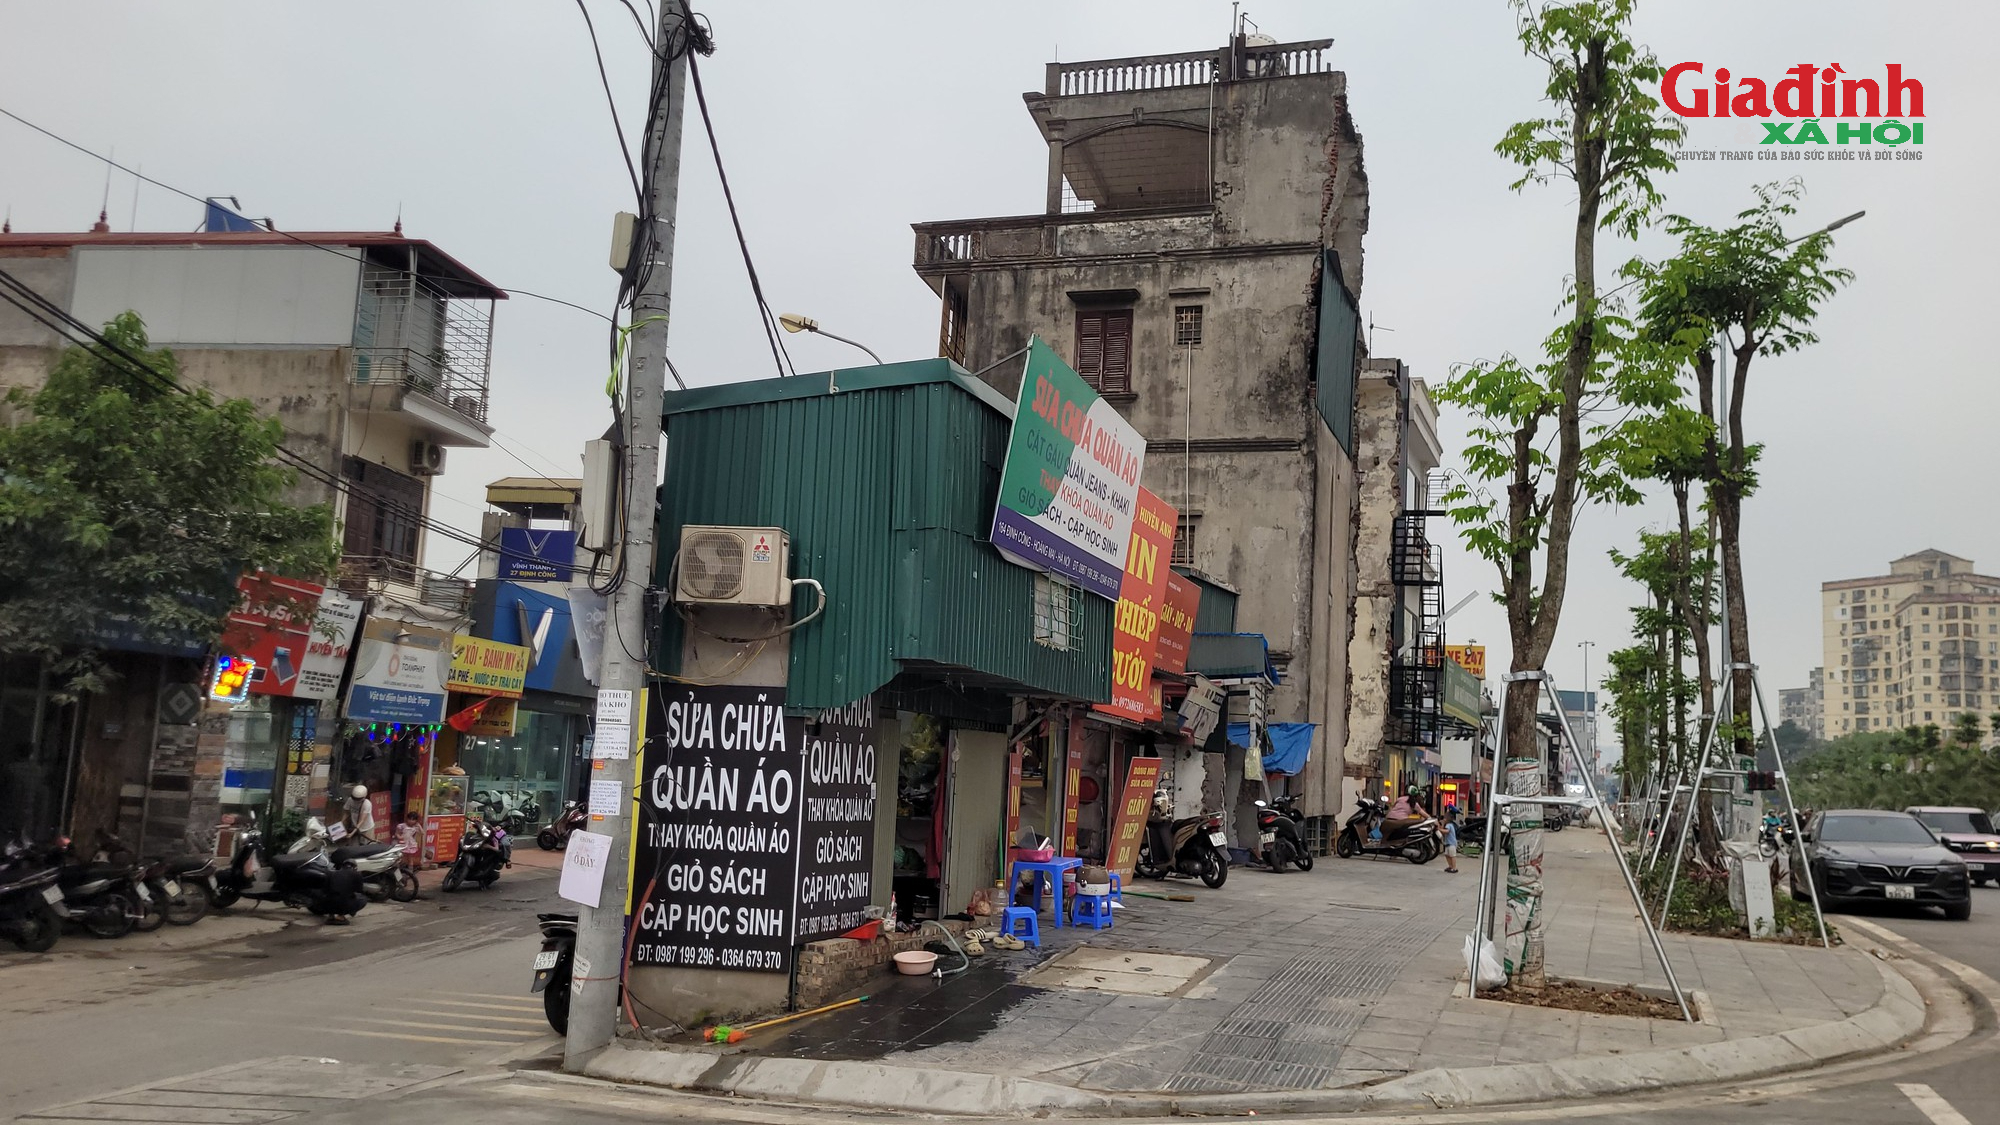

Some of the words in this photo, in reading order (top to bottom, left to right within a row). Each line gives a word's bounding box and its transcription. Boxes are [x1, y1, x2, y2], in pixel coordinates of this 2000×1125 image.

[1031, 369, 1060, 428] SỬA
[1093, 428, 1124, 477] QUẦN
[1121, 447, 1139, 487] ÁO
[1061, 483, 1082, 509] KHÓA
[1102, 507, 1114, 530] ÁO
[1085, 469, 1107, 501] JEANS
[1110, 489, 1130, 516] KHAKI
[1037, 498, 1062, 526] SÁCH
[1084, 526, 1101, 548] HỌC
[1101, 534, 1118, 557] SINH
[1159, 521, 1172, 539] ANH
[537, 570, 556, 578] CÔNG
[1127, 533, 1159, 585] IN
[463, 641, 479, 665] XÔI
[483, 645, 504, 670] BÁNH
[1464, 650, 1483, 665] 247
[667, 691, 714, 749] SỬA
[720, 693, 786, 752] CHỮA
[465, 736, 477, 750] 27
[810, 732, 852, 786] QUẦN
[854, 733, 875, 785] ÁO
[652, 756, 739, 812] QUẦN
[746, 757, 793, 814] ÁO
[1069, 768, 1080, 796] IN
[808, 798, 825, 821] THAY
[826, 792, 844, 821] KHÓA
[844, 793, 863, 822] QUẦN
[863, 793, 873, 821] ÁO
[1010, 786, 1020, 817] IN
[648, 823, 684, 848] THAY
[685, 819, 723, 850] KHÓA
[727, 821, 766, 853] QUẦN
[769, 822, 790, 853] ÁO
[816, 831, 834, 863] GIỎ
[836, 830, 862, 862] SÁCH
[1117, 846, 1131, 863] DA
[667, 859, 704, 892] GIỎ
[709, 860, 766, 895] SÁCH
[802, 872, 823, 910] CẶP
[825, 873, 846, 907] HỌC
[848, 872, 869, 899] SINH
[641, 899, 681, 937] CẶP
[687, 904, 730, 939] HỌC
[736, 907, 783, 936] SINH
[809, 917, 820, 934] 0987
[821, 915, 829, 932] 199
[829, 914, 838, 931] 296
[638, 944, 652, 962] ĐT:
[655, 945, 677, 963] 0987
[680, 946, 695, 964] 199
[698, 947, 714, 965] 296
[722, 948, 744, 966] 0364
[746, 950, 762, 968] 679
[765, 951, 781, 969] 370
